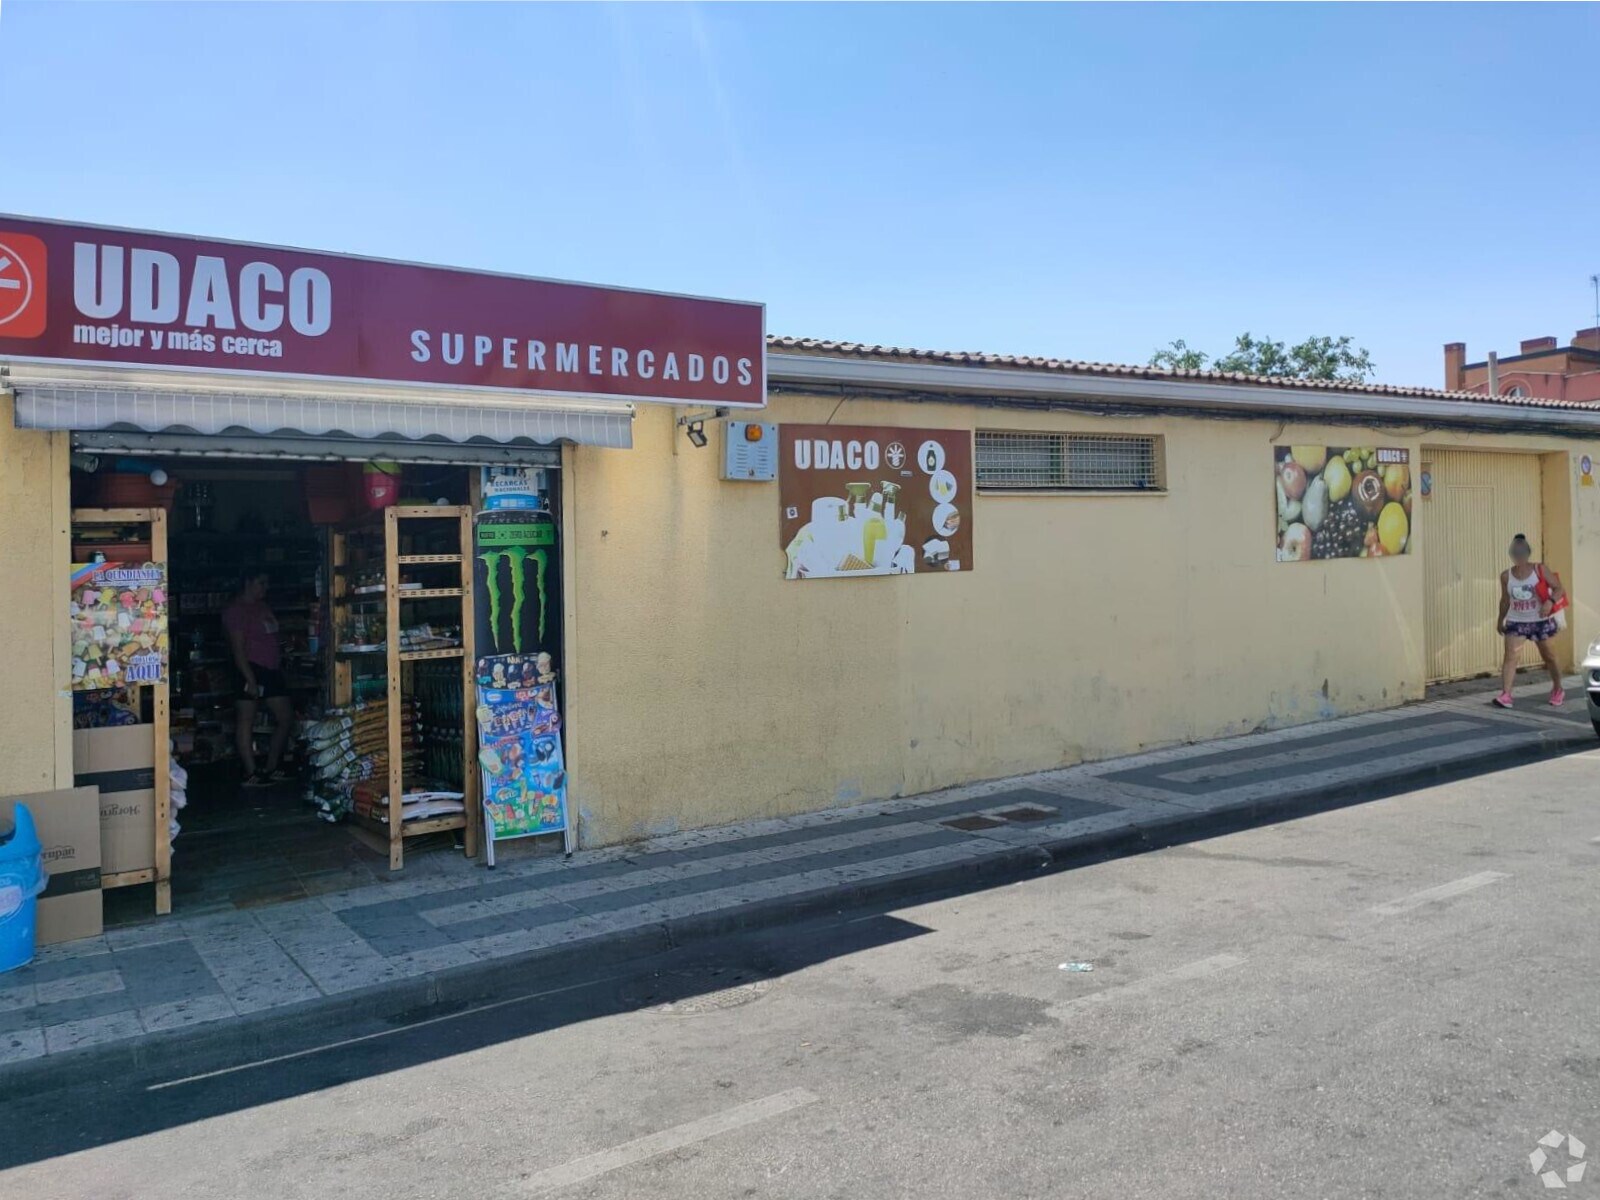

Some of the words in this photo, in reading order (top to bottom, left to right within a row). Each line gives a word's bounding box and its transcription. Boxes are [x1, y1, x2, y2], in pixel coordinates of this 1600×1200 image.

[73, 241, 332, 337] UDACO
[73, 324, 144, 347] mejor
[150, 330, 163, 350] y
[168, 329, 216, 352] más
[222, 336, 283, 357] cerca
[410, 329, 752, 386] SUPERMERCADOS
[794, 440, 880, 470] UDACO
